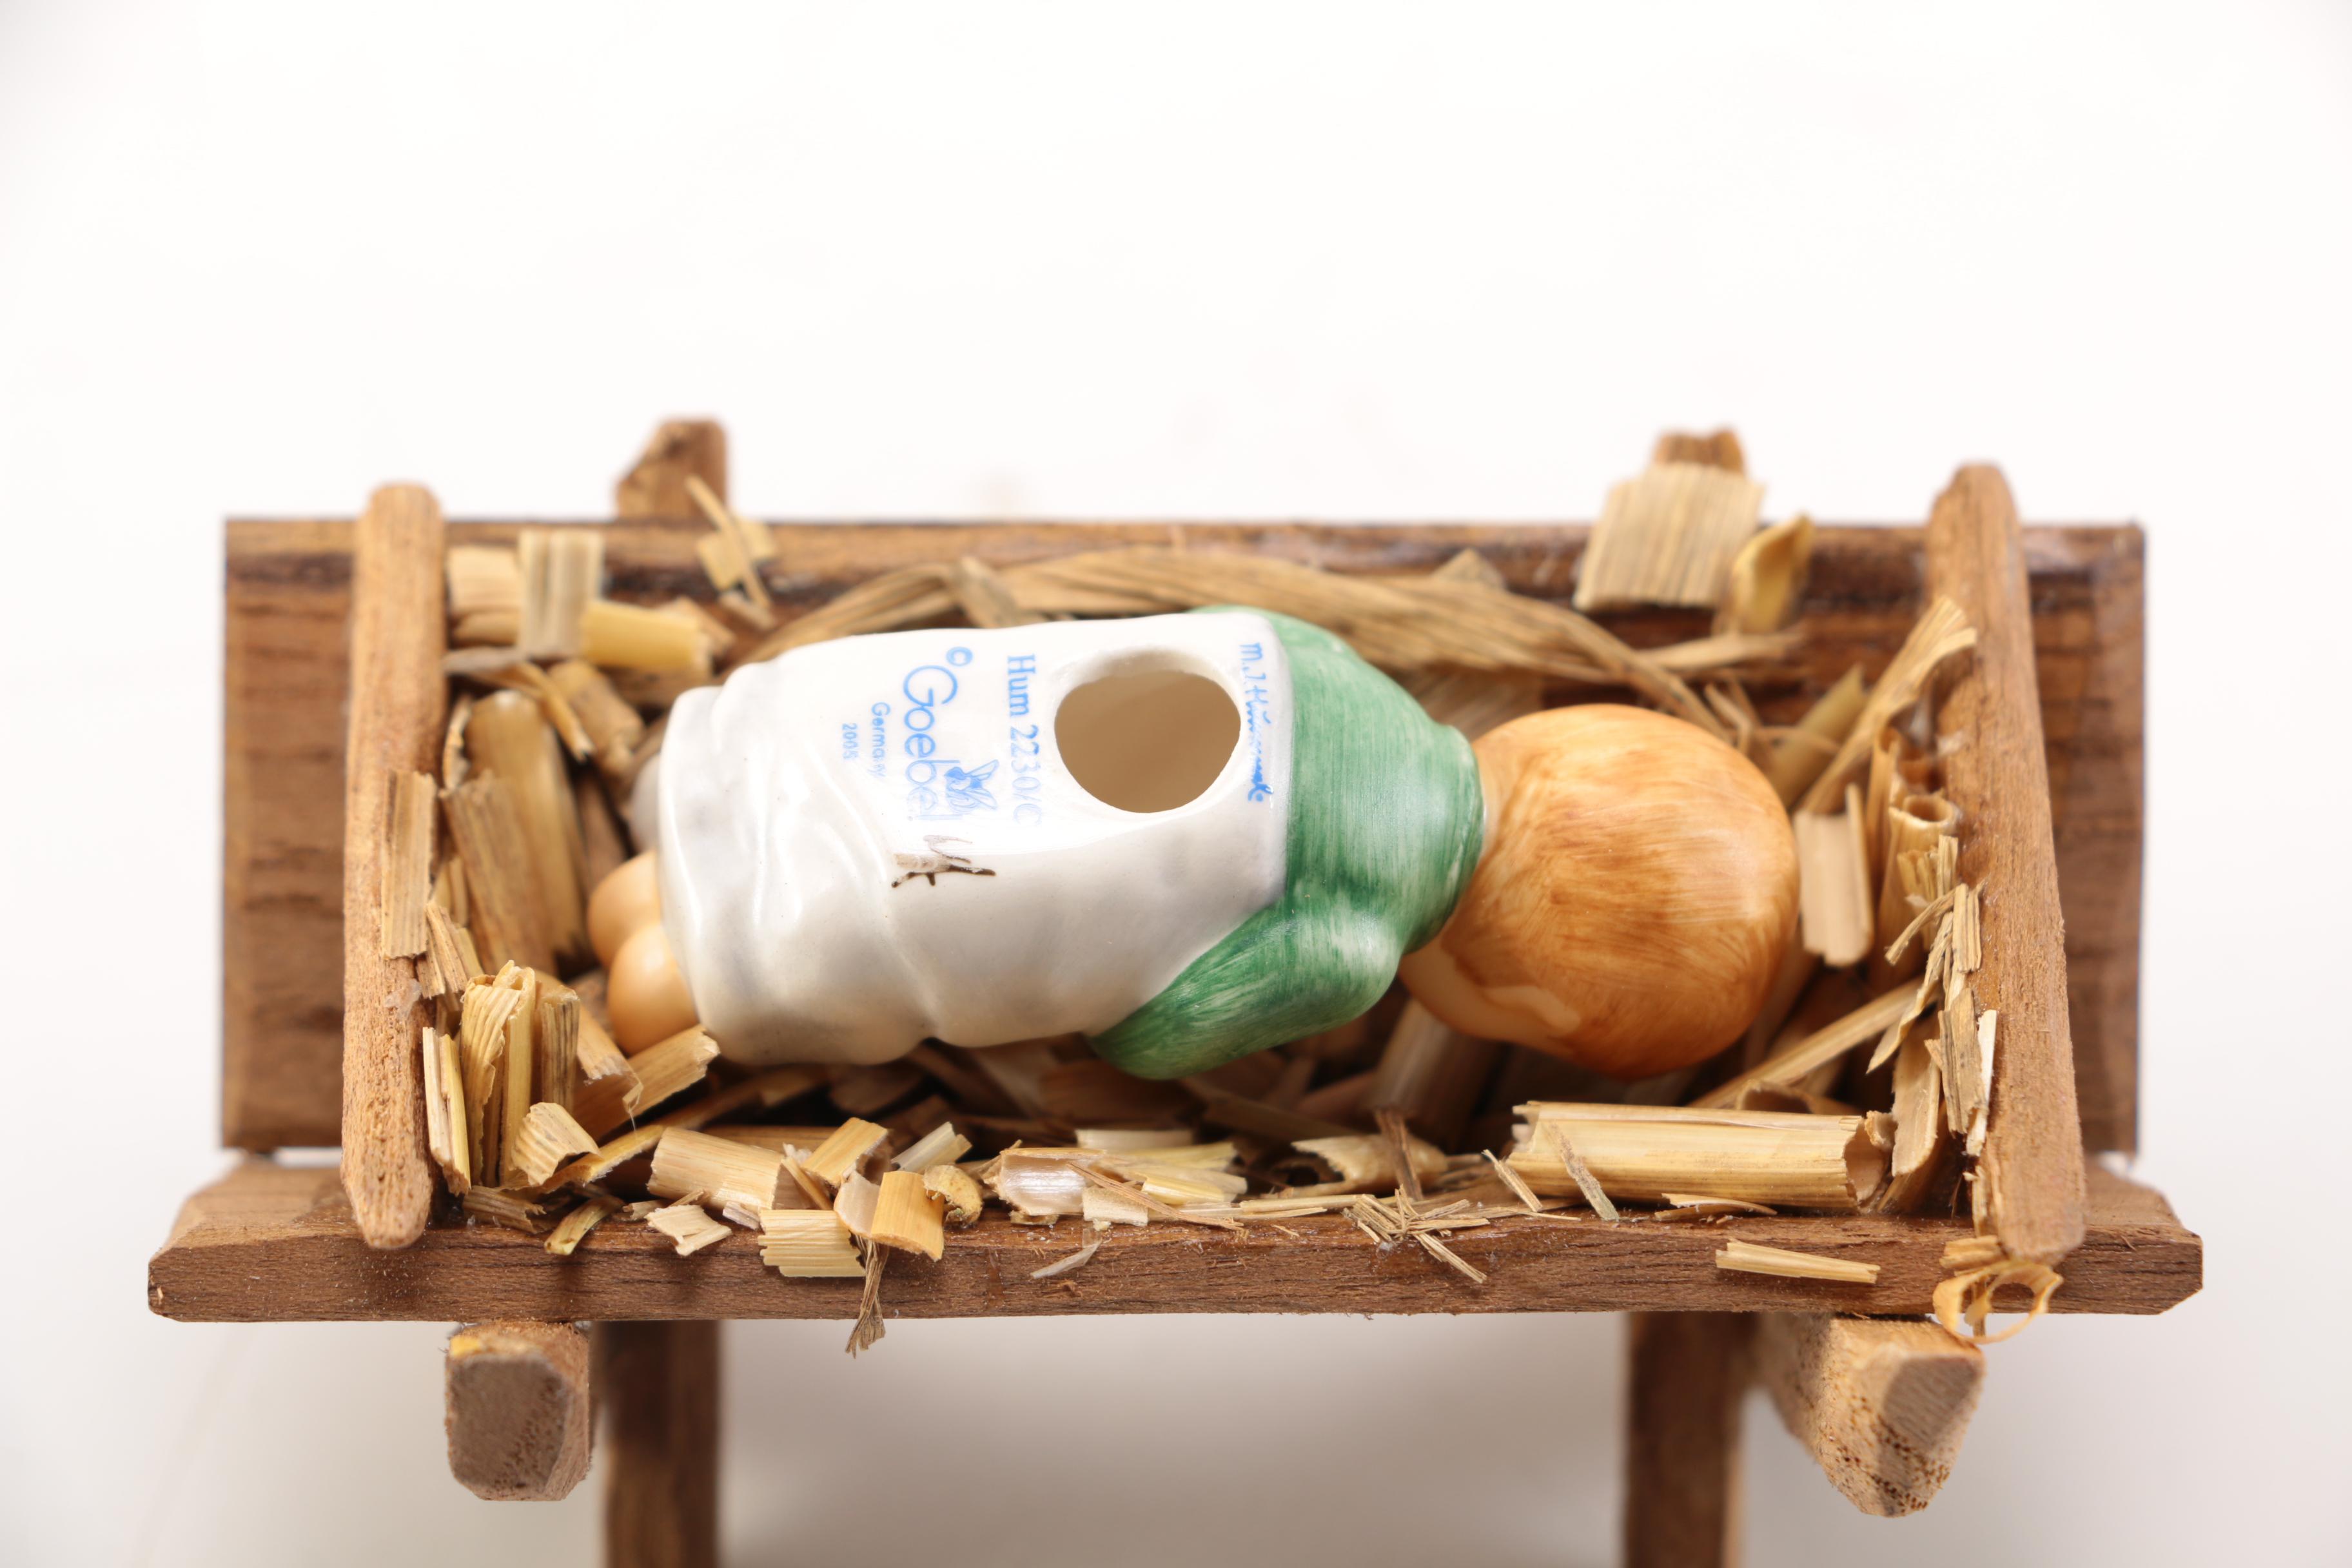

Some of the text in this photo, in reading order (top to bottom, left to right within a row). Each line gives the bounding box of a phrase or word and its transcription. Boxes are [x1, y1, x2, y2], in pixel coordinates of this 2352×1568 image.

[842, 722, 859, 760] 2005
[868, 701, 891, 778] Germany
[903, 665, 963, 820] Goebel
[1008, 654, 1043, 825] Hum 2230/C
